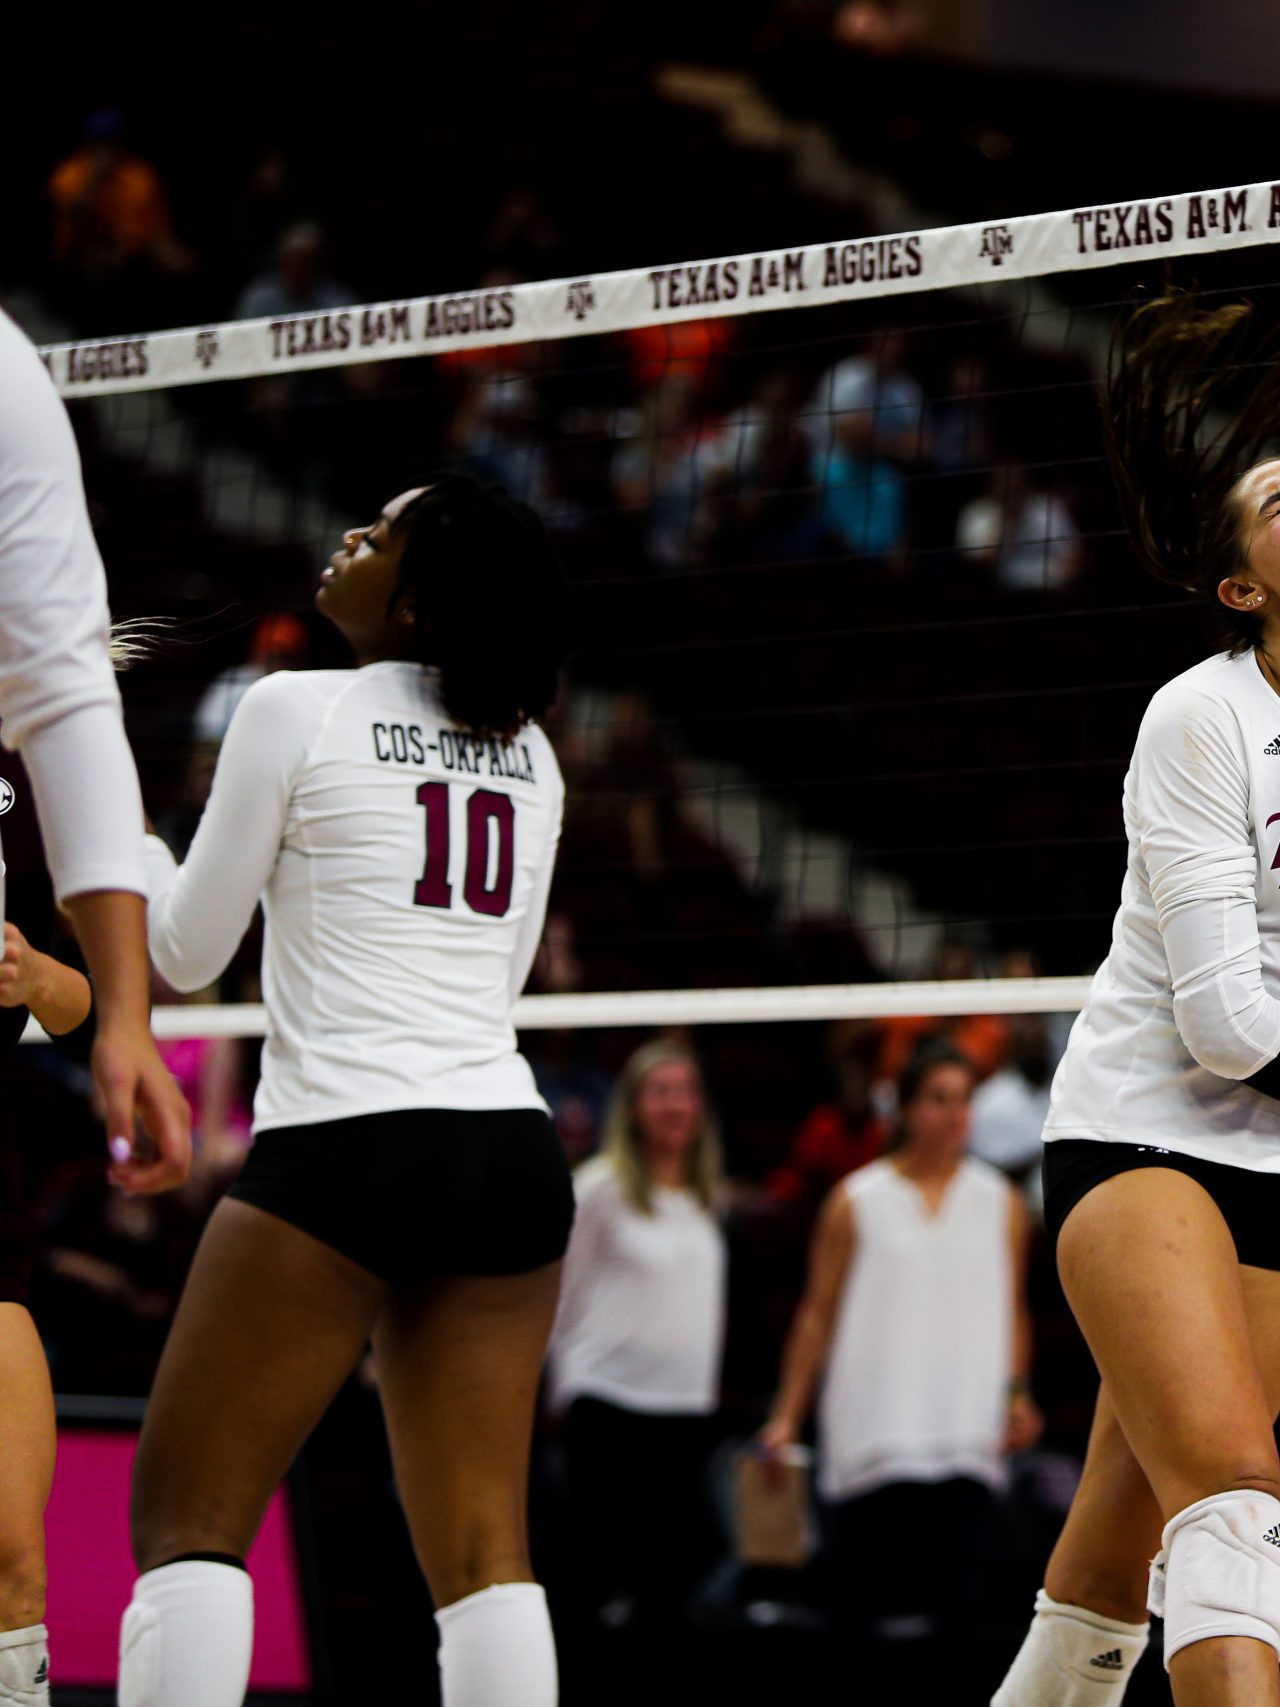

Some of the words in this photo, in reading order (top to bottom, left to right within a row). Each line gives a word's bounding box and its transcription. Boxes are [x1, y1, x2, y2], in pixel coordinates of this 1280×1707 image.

[1073, 201, 1173, 254] TEXAS
[1186, 189, 1249, 239] A&M
[649, 261, 739, 310] TEXAS
[748, 251, 806, 297] A&M
[823, 235, 922, 287] AGGIES
[269, 313, 351, 360] TEXAS
[424, 290, 515, 340] AGGIES
[67, 338, 149, 384] AGGIES
[413, 781, 515, 918] 10
